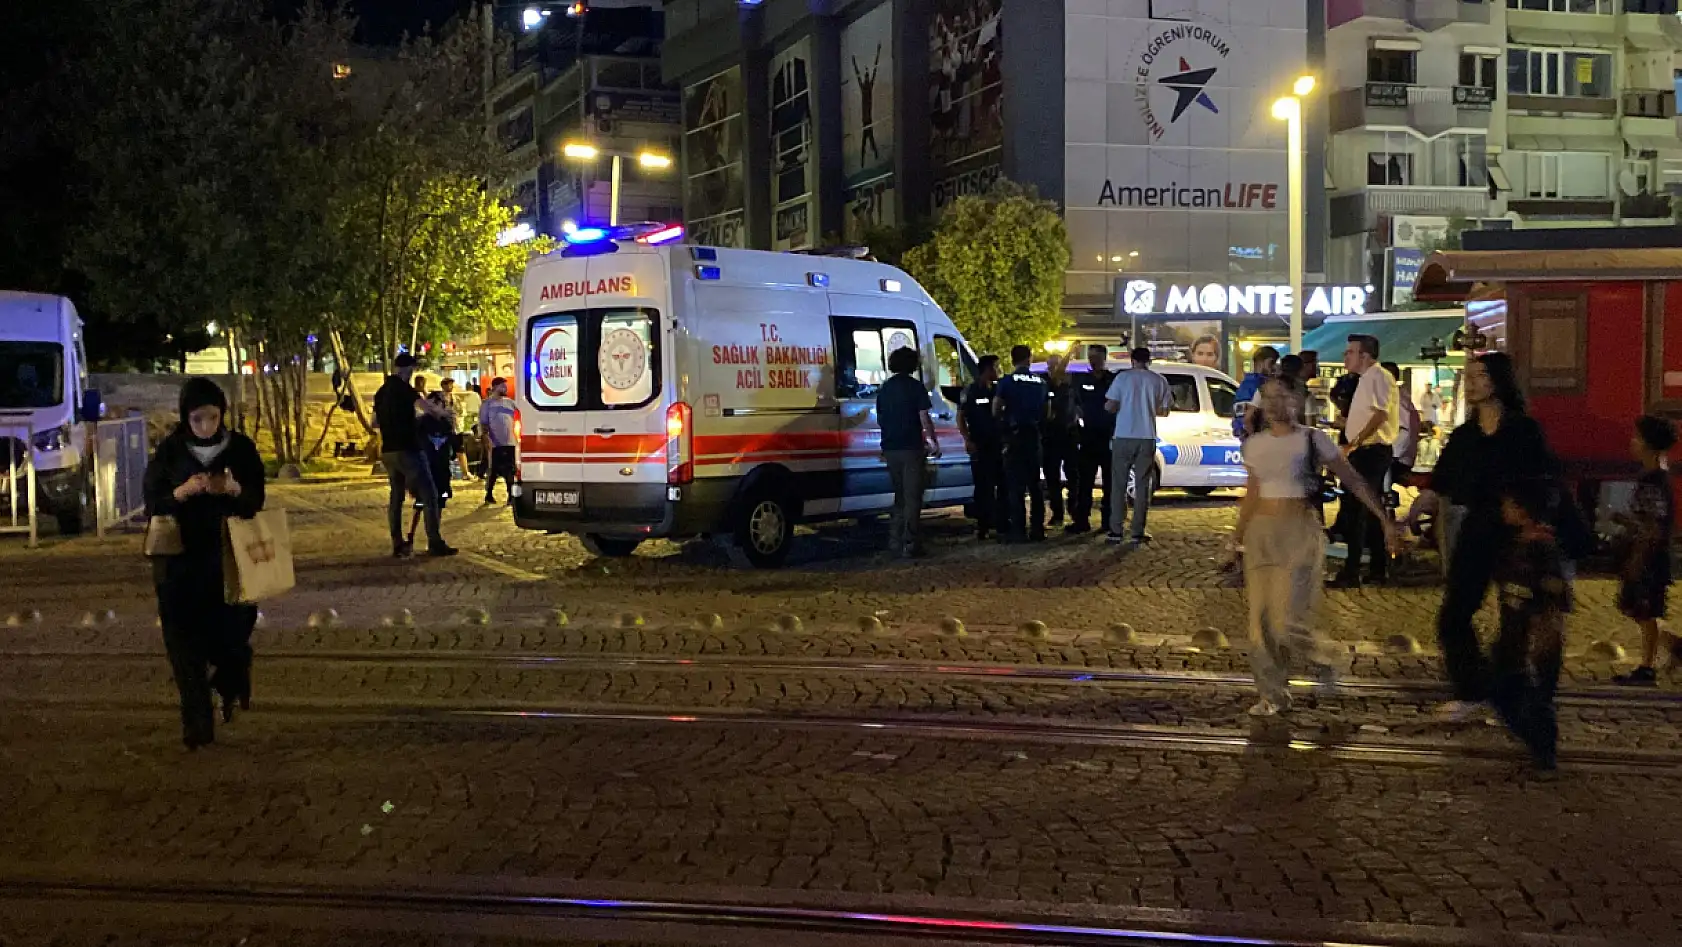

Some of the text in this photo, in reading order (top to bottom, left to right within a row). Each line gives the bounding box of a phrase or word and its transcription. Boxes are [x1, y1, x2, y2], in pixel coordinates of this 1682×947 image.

[1098, 179, 1278, 208] AmericanLIFE
[540, 276, 632, 300] AMBULANS
[1166, 283, 1293, 315] MONTE
[760, 323, 782, 342] T.C.
[713, 341, 828, 365] SAĞLIK BAKANLIĞI
[544, 363, 573, 379] SAĞLIK
[768, 368, 811, 389] SAĞLIK
